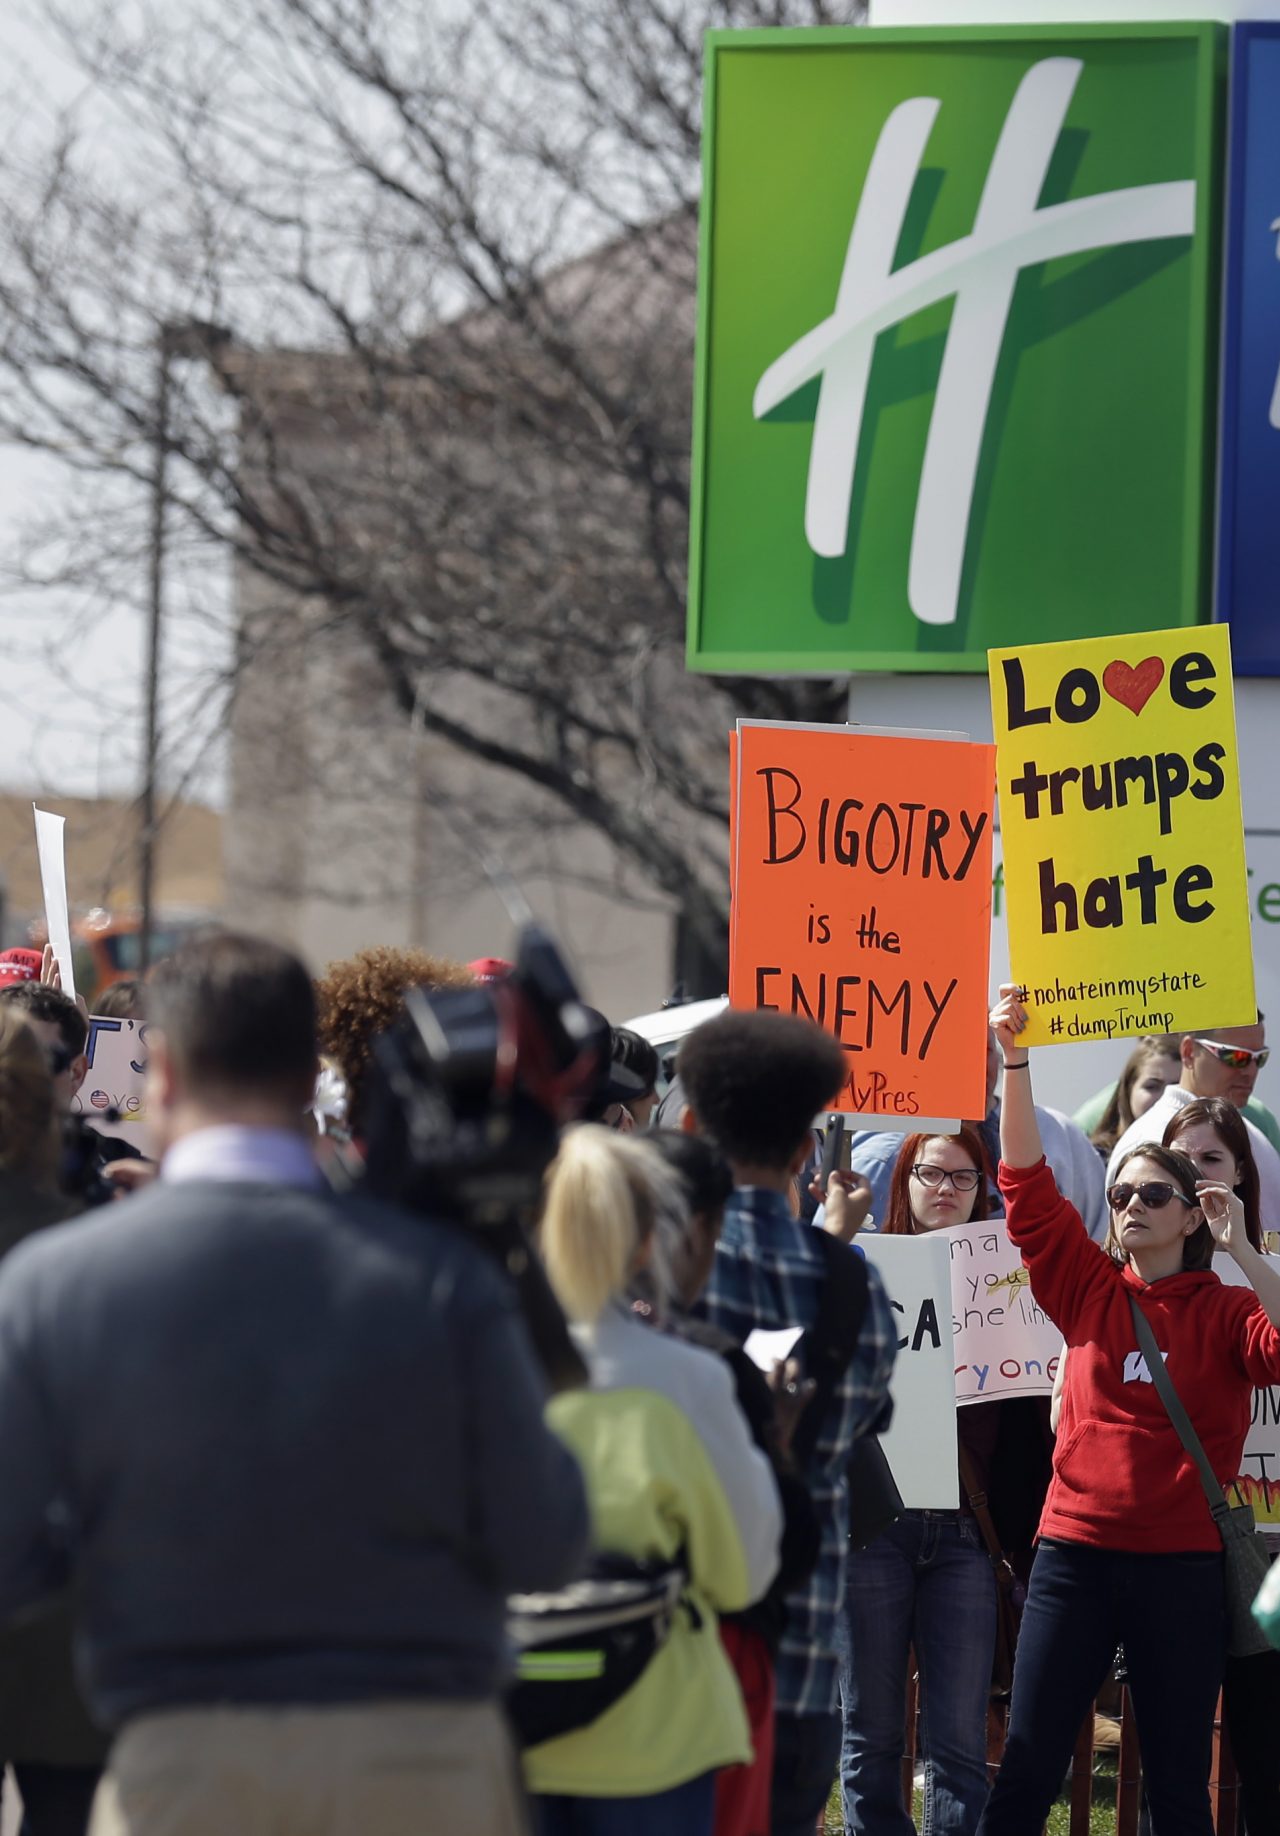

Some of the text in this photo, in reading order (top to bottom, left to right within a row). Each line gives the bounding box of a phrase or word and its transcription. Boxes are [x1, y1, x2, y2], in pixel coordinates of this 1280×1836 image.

[756, 767, 988, 881] BIGOTRY
[1010, 742, 1226, 836] trumps
[808, 904, 901, 954] is the
[1038, 855, 1216, 935] hate
[1049, 1007, 1174, 1039] #dumpTrump
